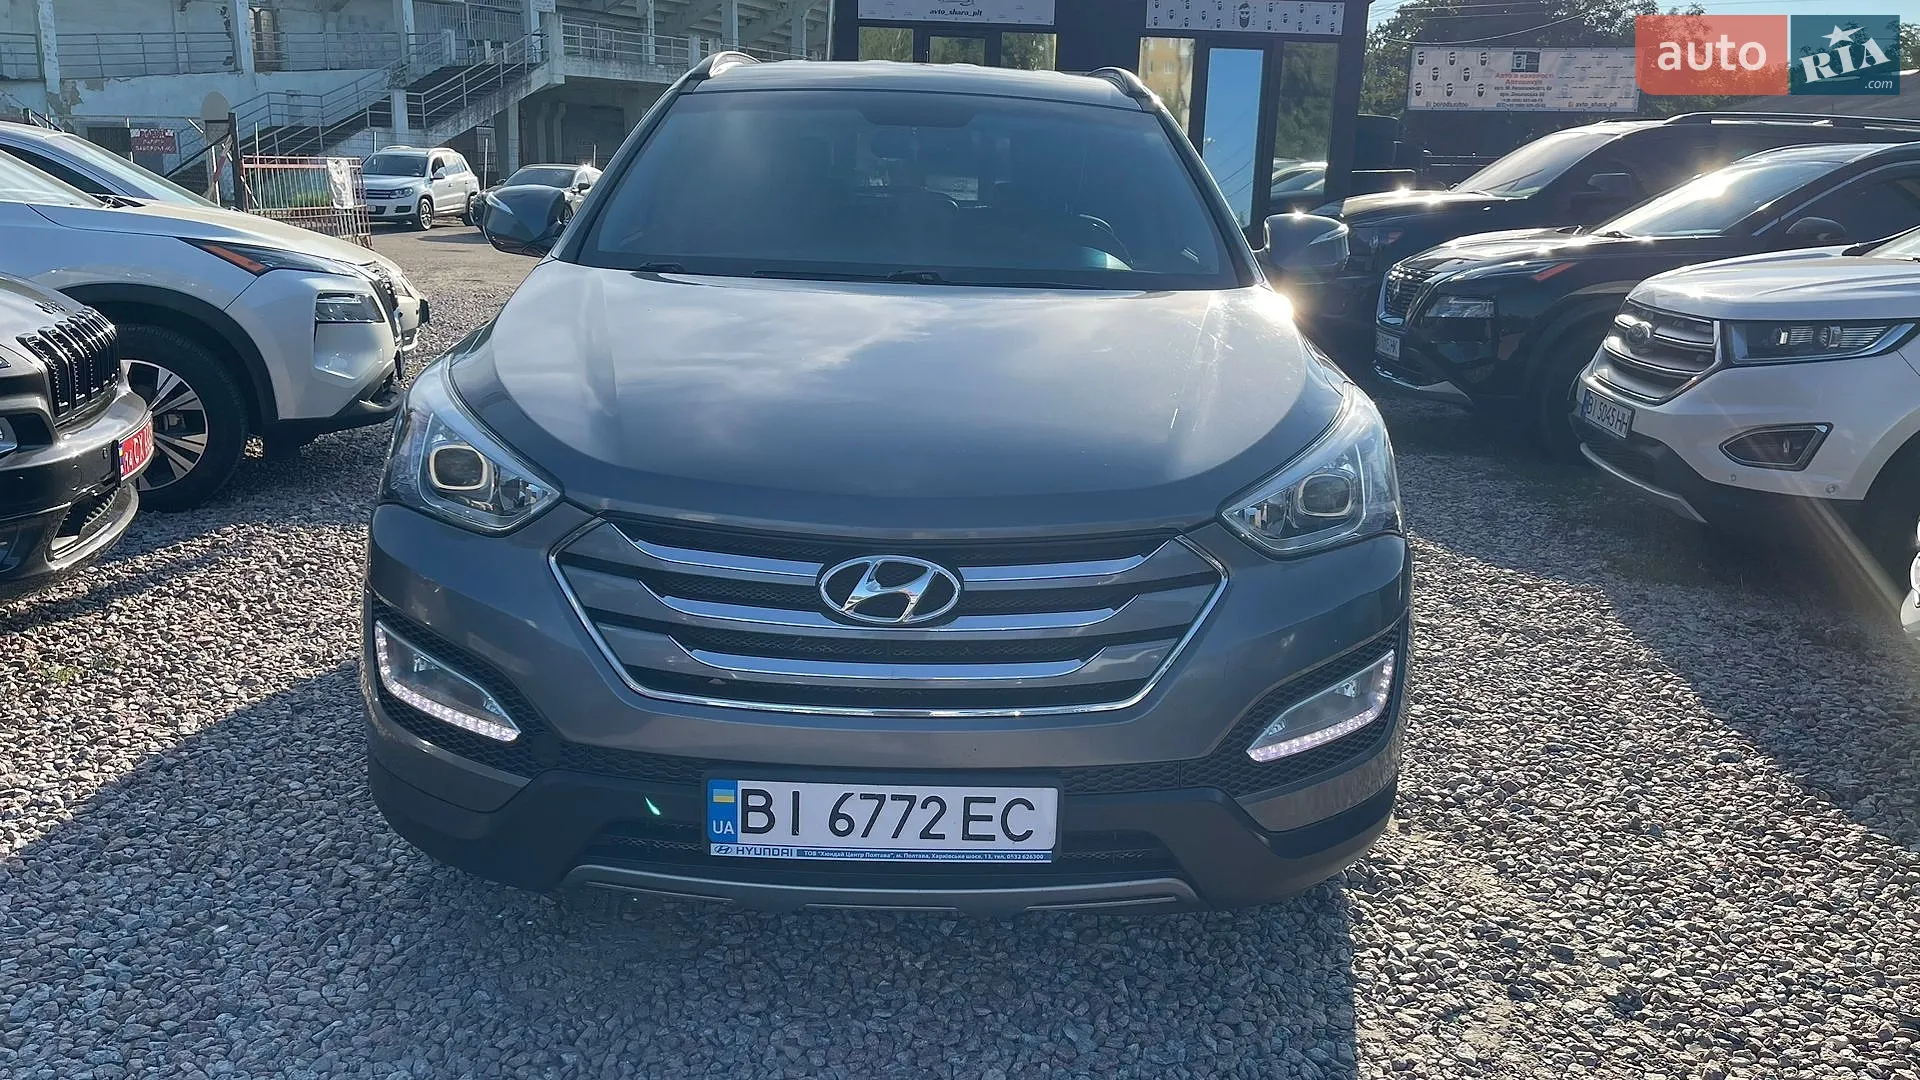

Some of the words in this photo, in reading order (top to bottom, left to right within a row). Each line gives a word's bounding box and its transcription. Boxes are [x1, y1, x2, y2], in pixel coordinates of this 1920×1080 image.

[929, 9, 983, 17] avto_shara_plt
[740, 788, 800, 836] BI
[828, 792, 947, 840] 6772
[961, 796, 1035, 842] EC
[712, 819, 735, 835] UA
[736, 846, 793, 857] HYUNDAI
[845, 852, 864, 860] Центр
